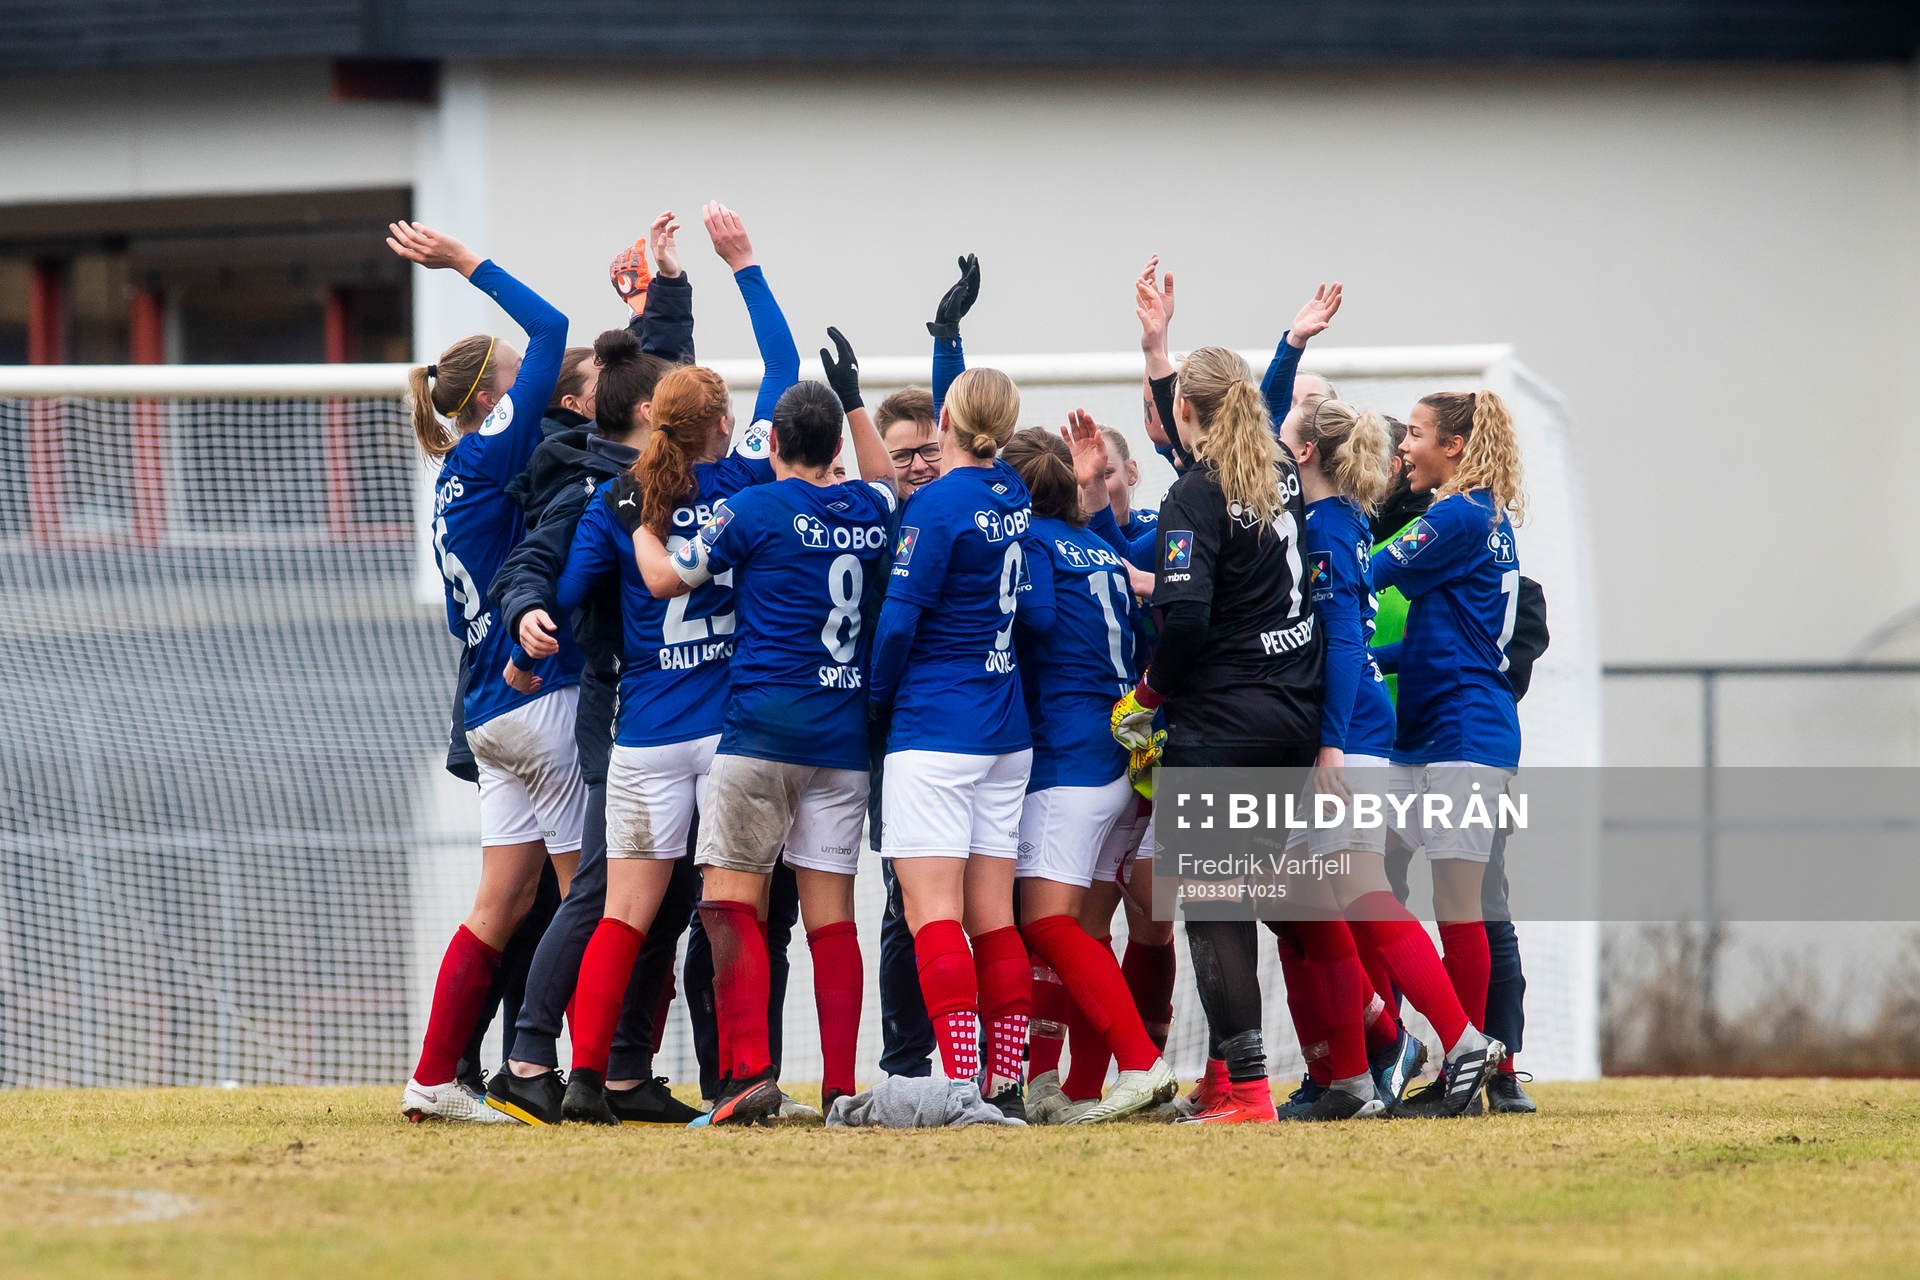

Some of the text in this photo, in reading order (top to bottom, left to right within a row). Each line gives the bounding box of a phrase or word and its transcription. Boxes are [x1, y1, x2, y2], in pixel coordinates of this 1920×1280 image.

[821, 554, 863, 663] 8
[994, 540, 1022, 651] 9
[1271, 510, 1303, 619] 1
